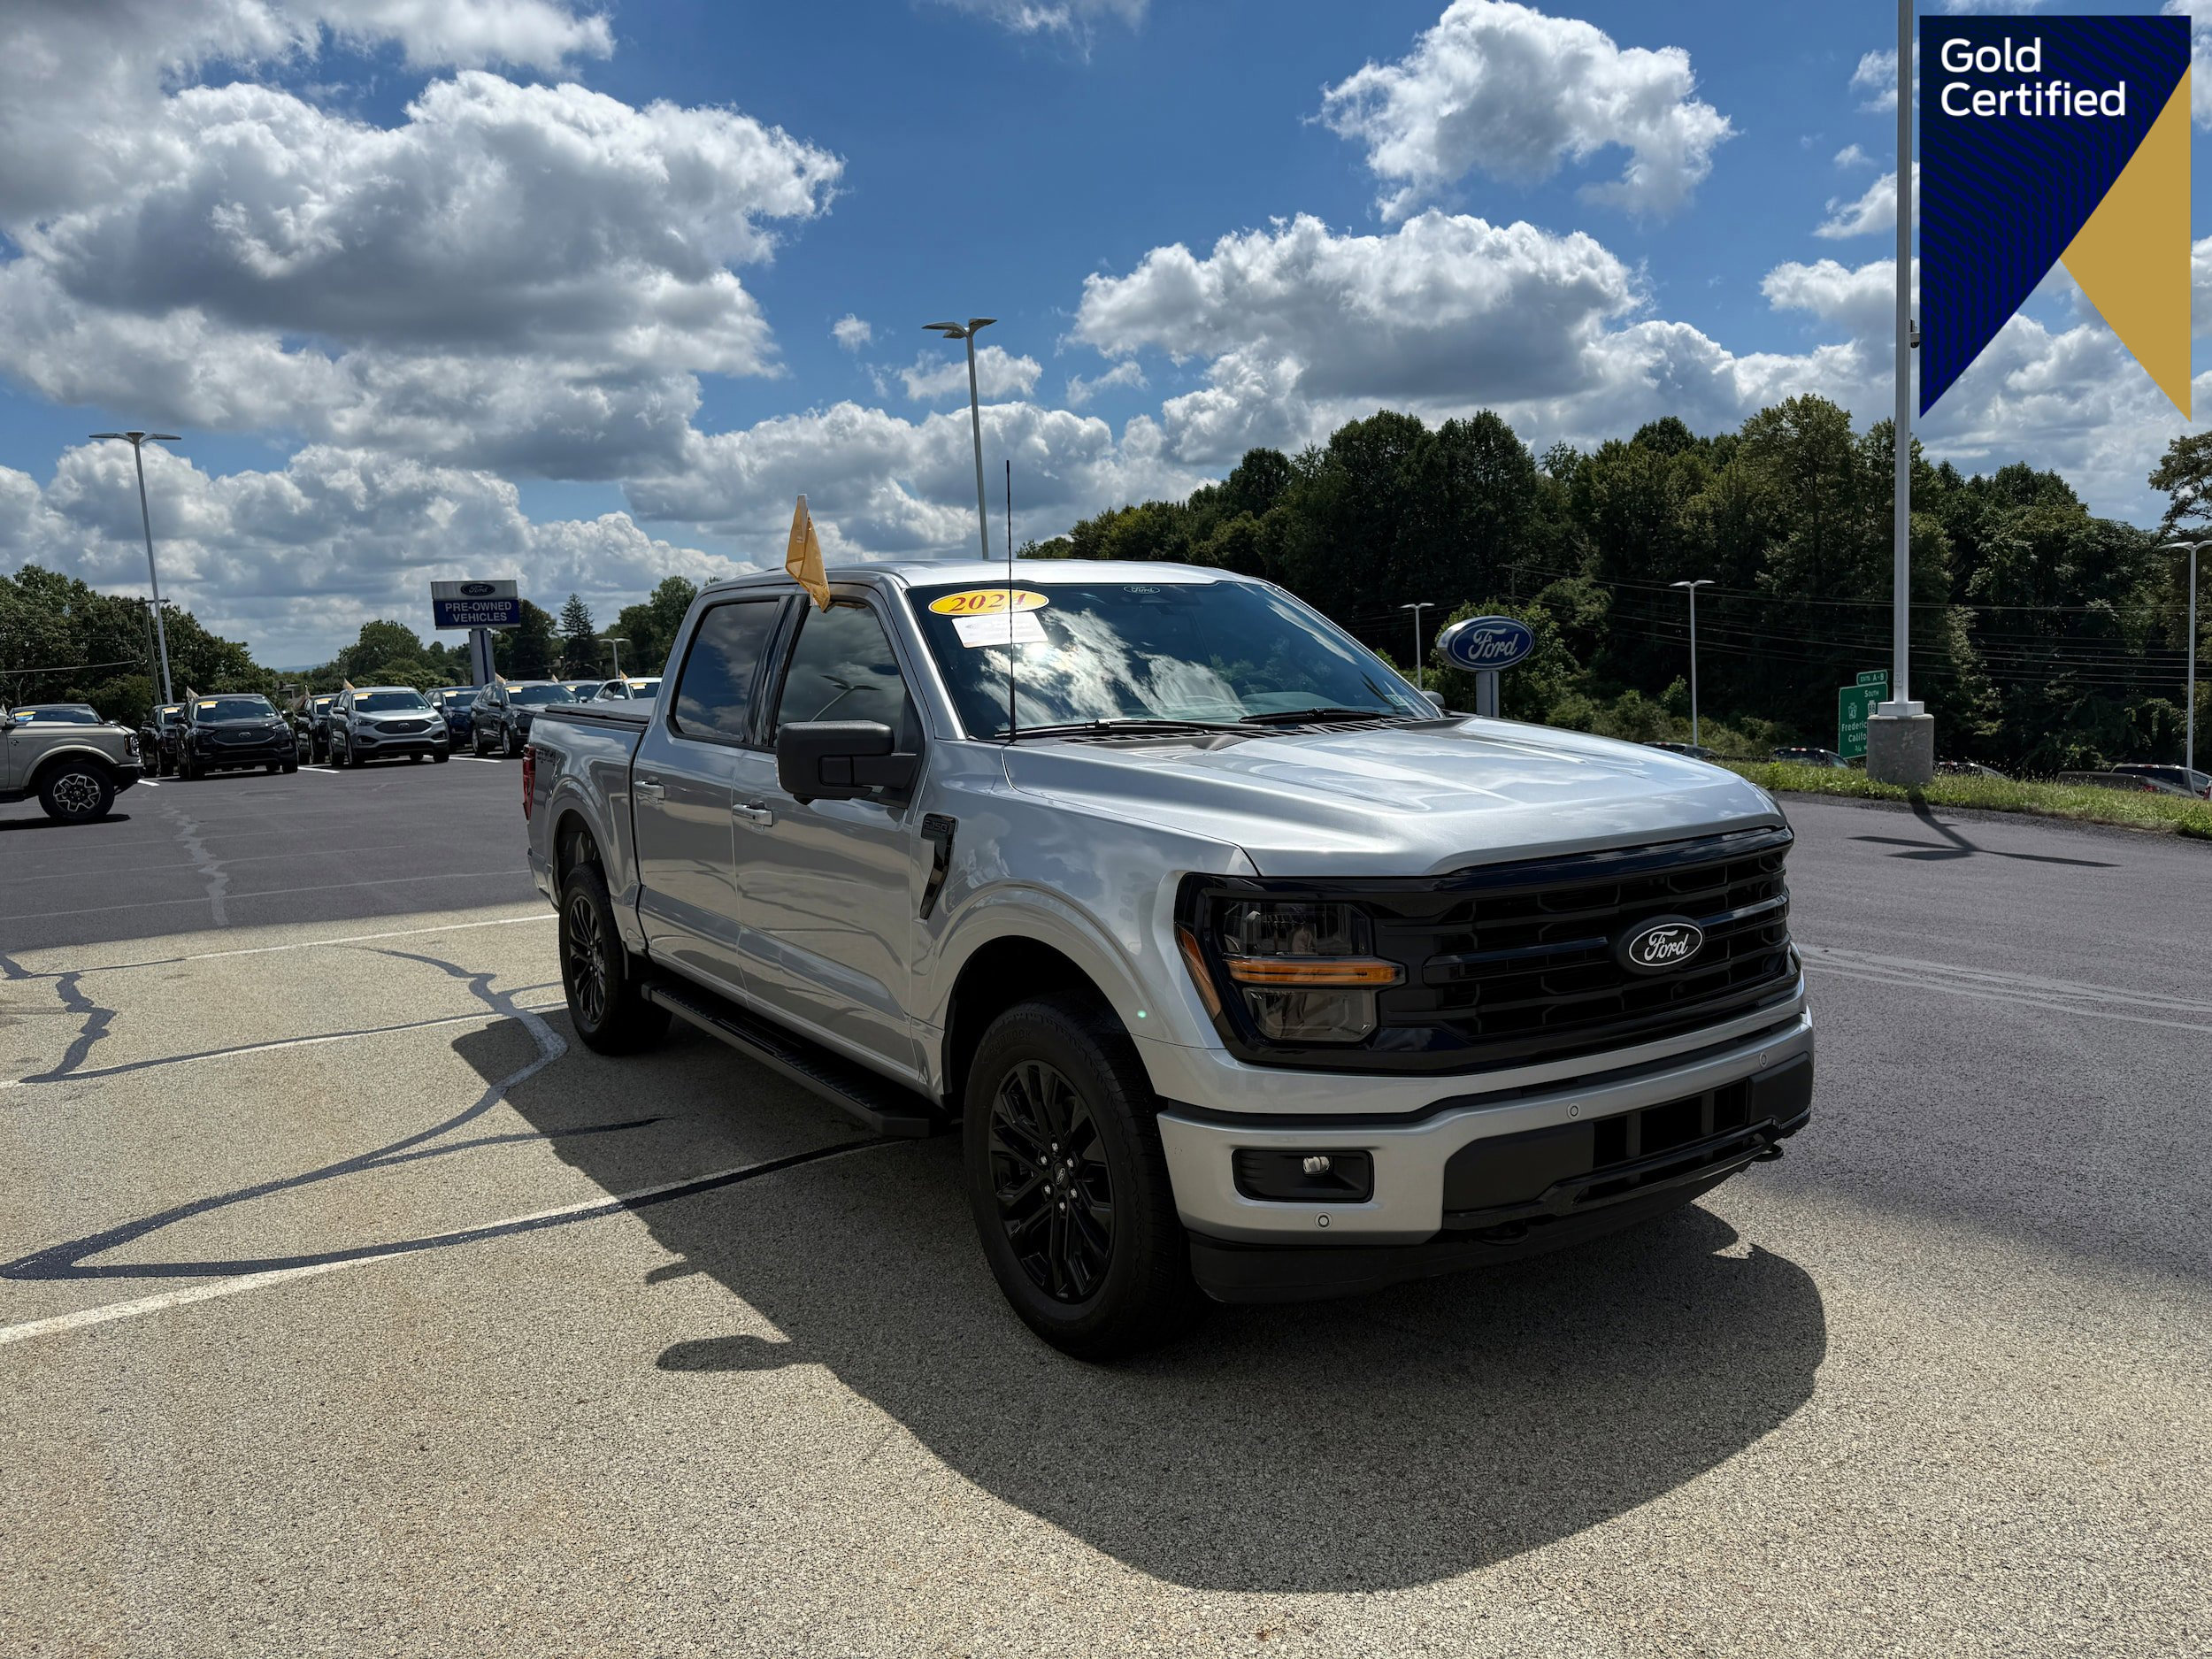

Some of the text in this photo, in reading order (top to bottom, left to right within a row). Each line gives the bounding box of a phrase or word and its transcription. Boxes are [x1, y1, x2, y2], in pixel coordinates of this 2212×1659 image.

[444, 601, 512, 612] PRE-OWNED
[452, 612, 508, 623] VEHICLES
[1468, 627, 1519, 660] Ford
[1841, 719, 1868, 732] Frederic
[1848, 732, 1867, 742] Califo
[1644, 929, 1689, 961] Ford
